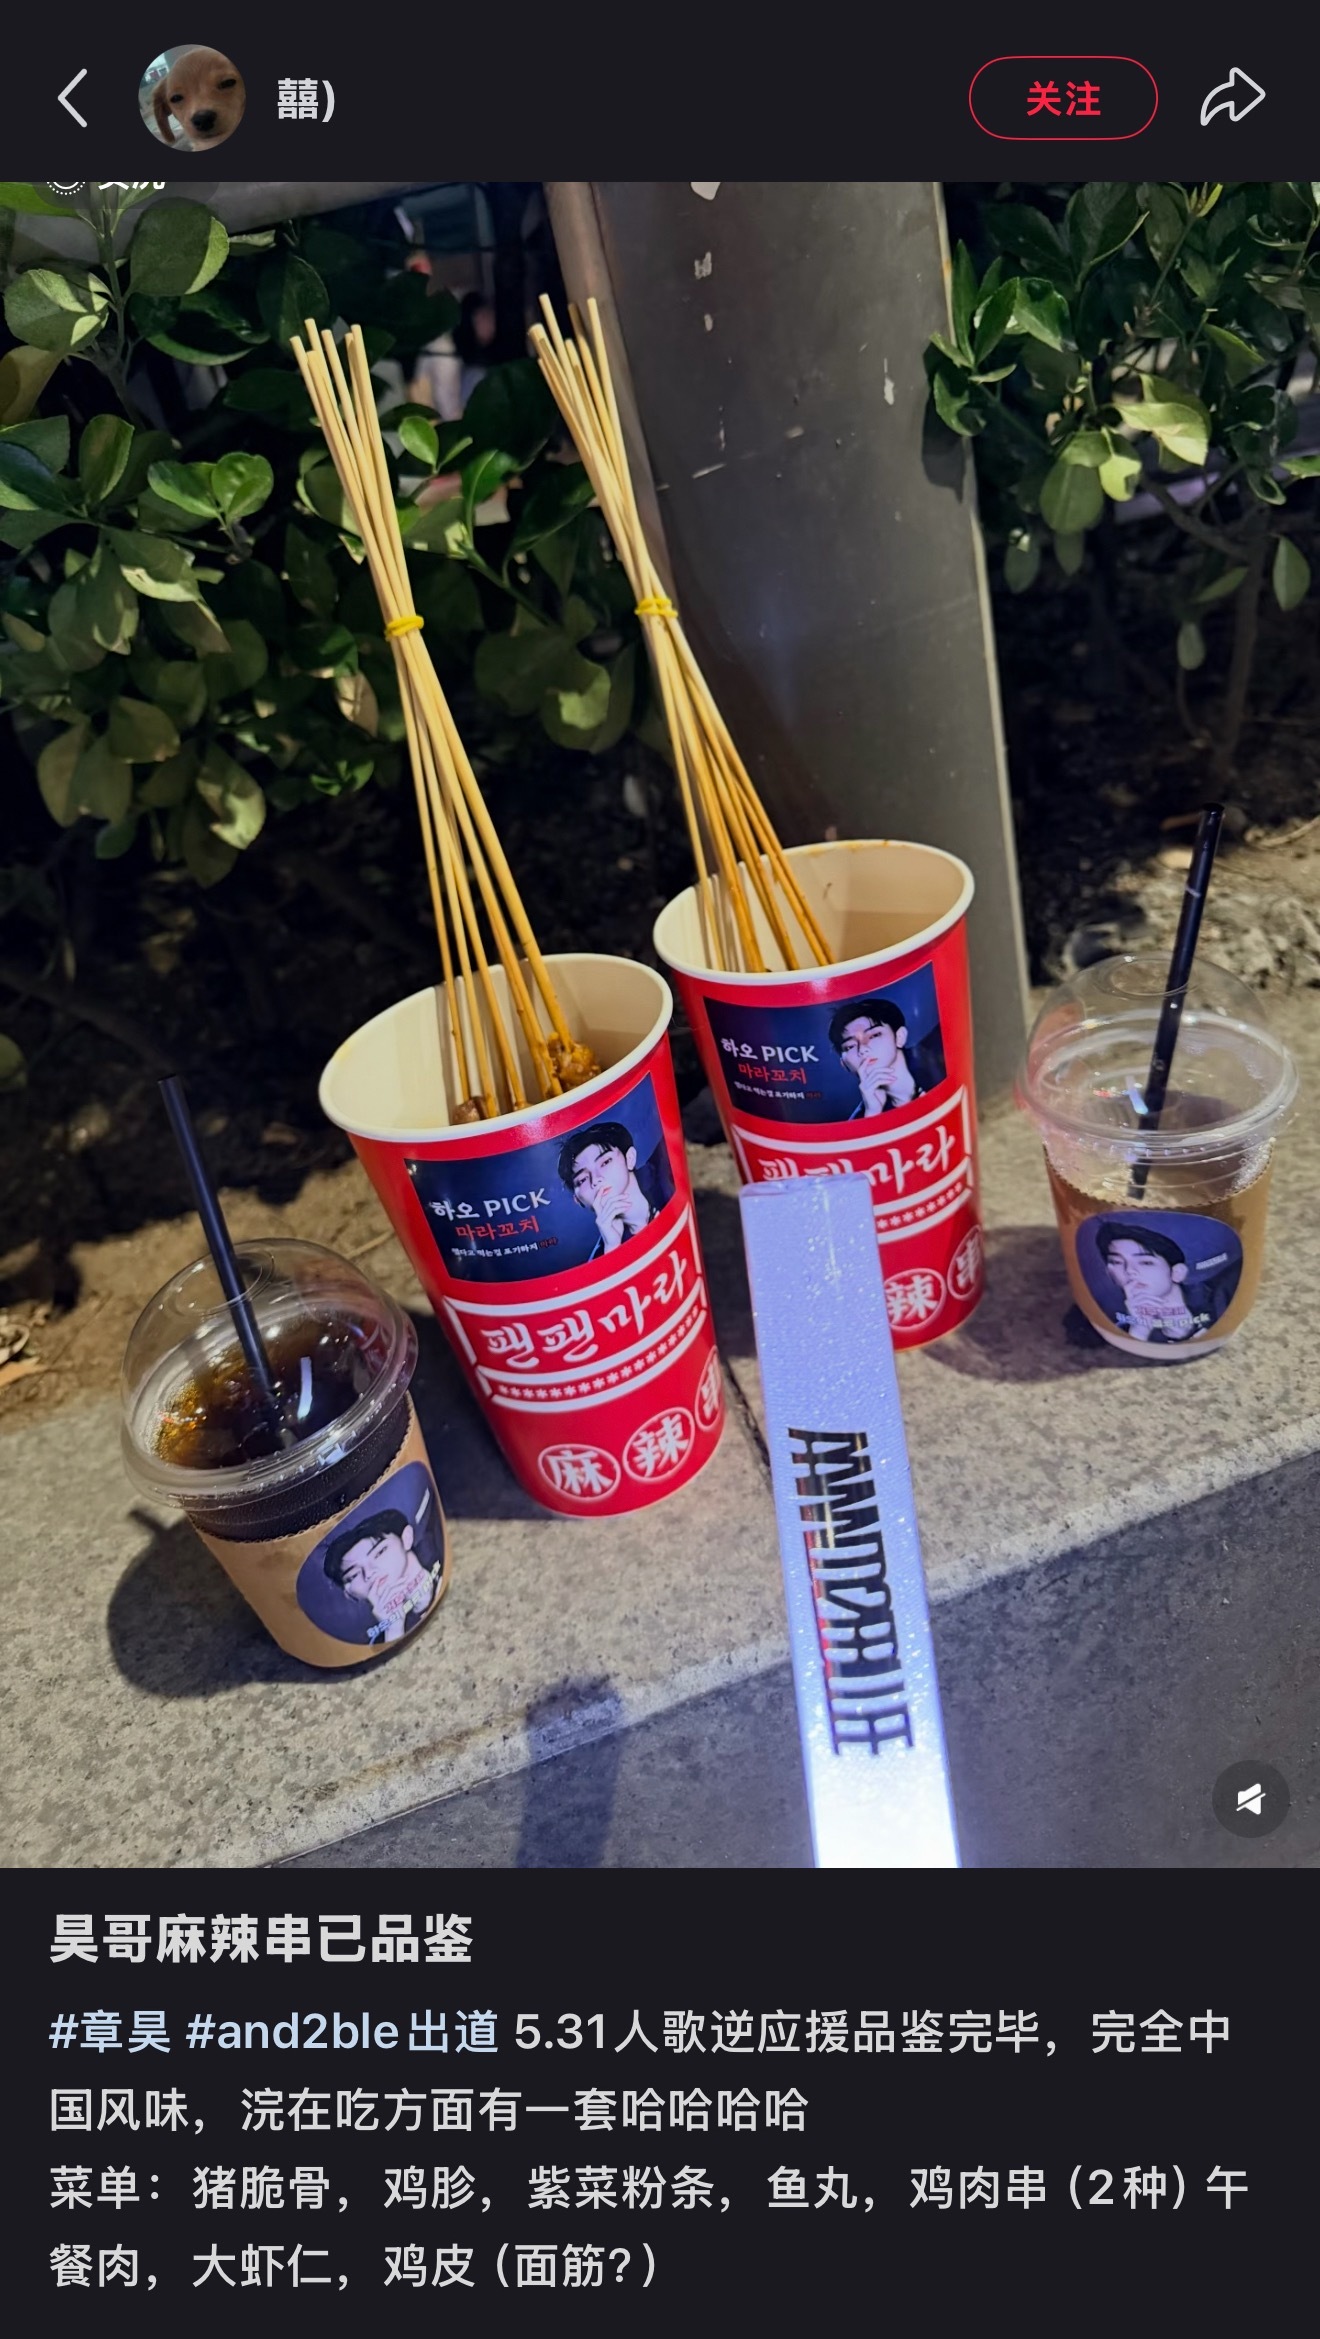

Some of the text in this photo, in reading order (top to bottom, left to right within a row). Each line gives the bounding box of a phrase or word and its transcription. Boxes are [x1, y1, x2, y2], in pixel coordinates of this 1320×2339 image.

[721, 1037, 820, 1064] 하오 PICK
[737, 1062, 808, 1085] 마라꼬치
[428, 1187, 551, 1222] 하오 PICK
[455, 1215, 541, 1242] 마라꼬치
[480, 1249, 688, 1370] 팬팬마라
